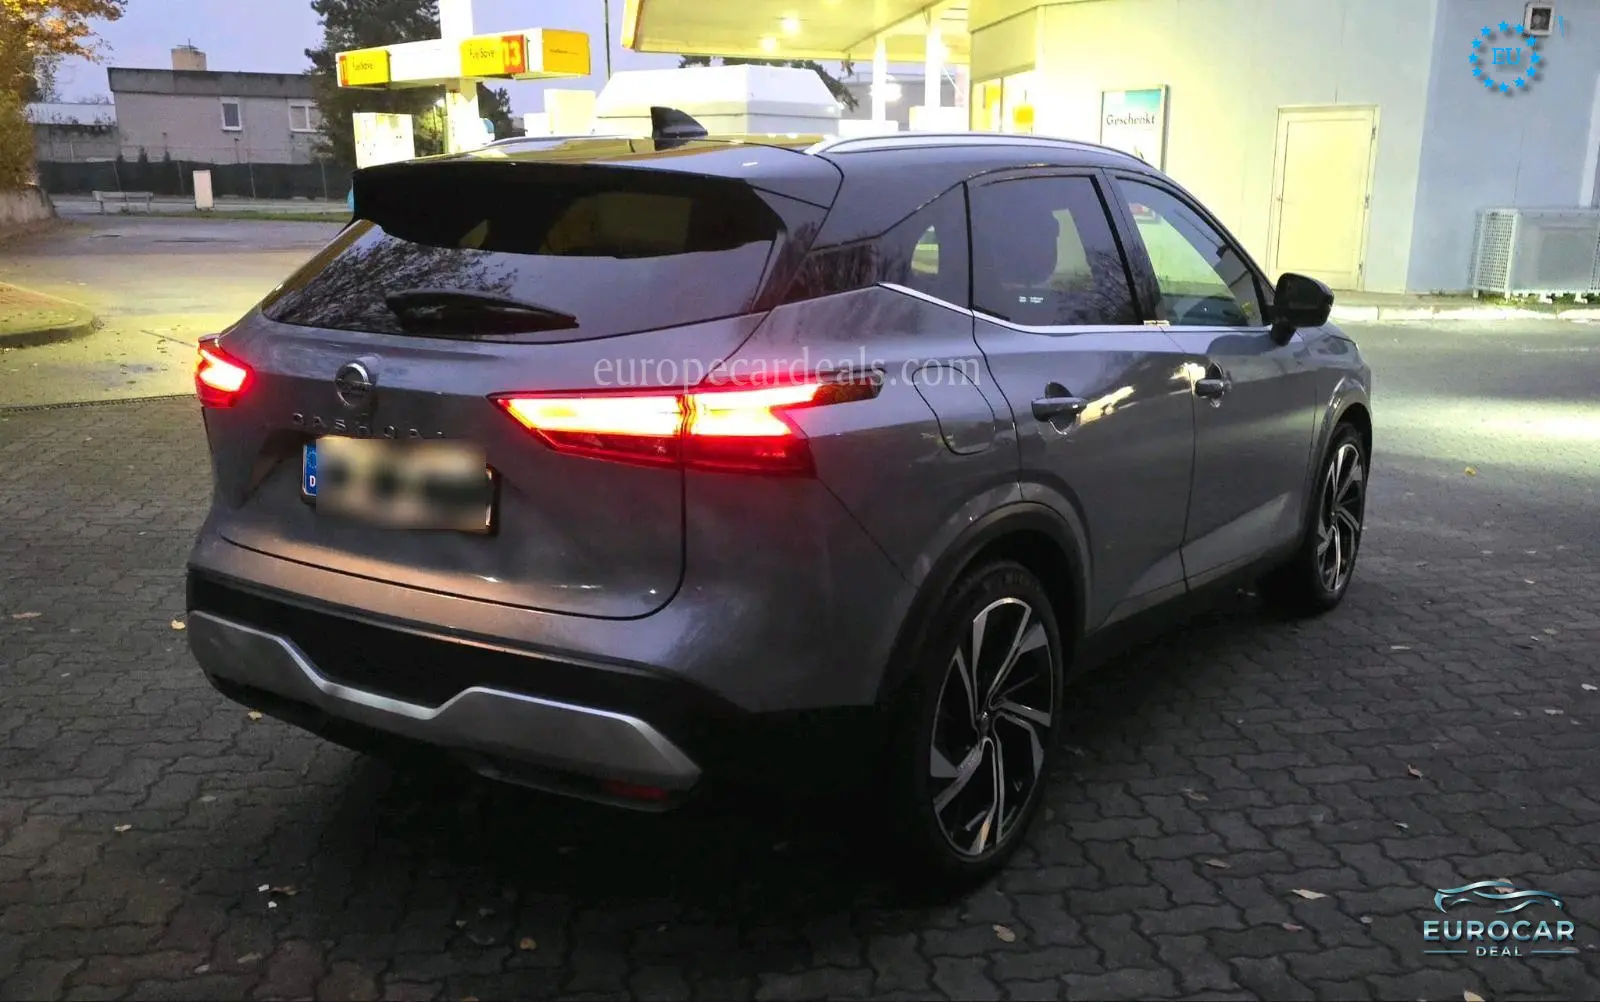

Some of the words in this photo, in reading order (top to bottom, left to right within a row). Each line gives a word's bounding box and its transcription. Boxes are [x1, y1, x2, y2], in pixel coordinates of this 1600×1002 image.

[501, 40, 522, 67] 13
[1106, 112, 1155, 126] Geschenkt
[292, 412, 443, 439] QASQA
[309, 475, 316, 488] D
